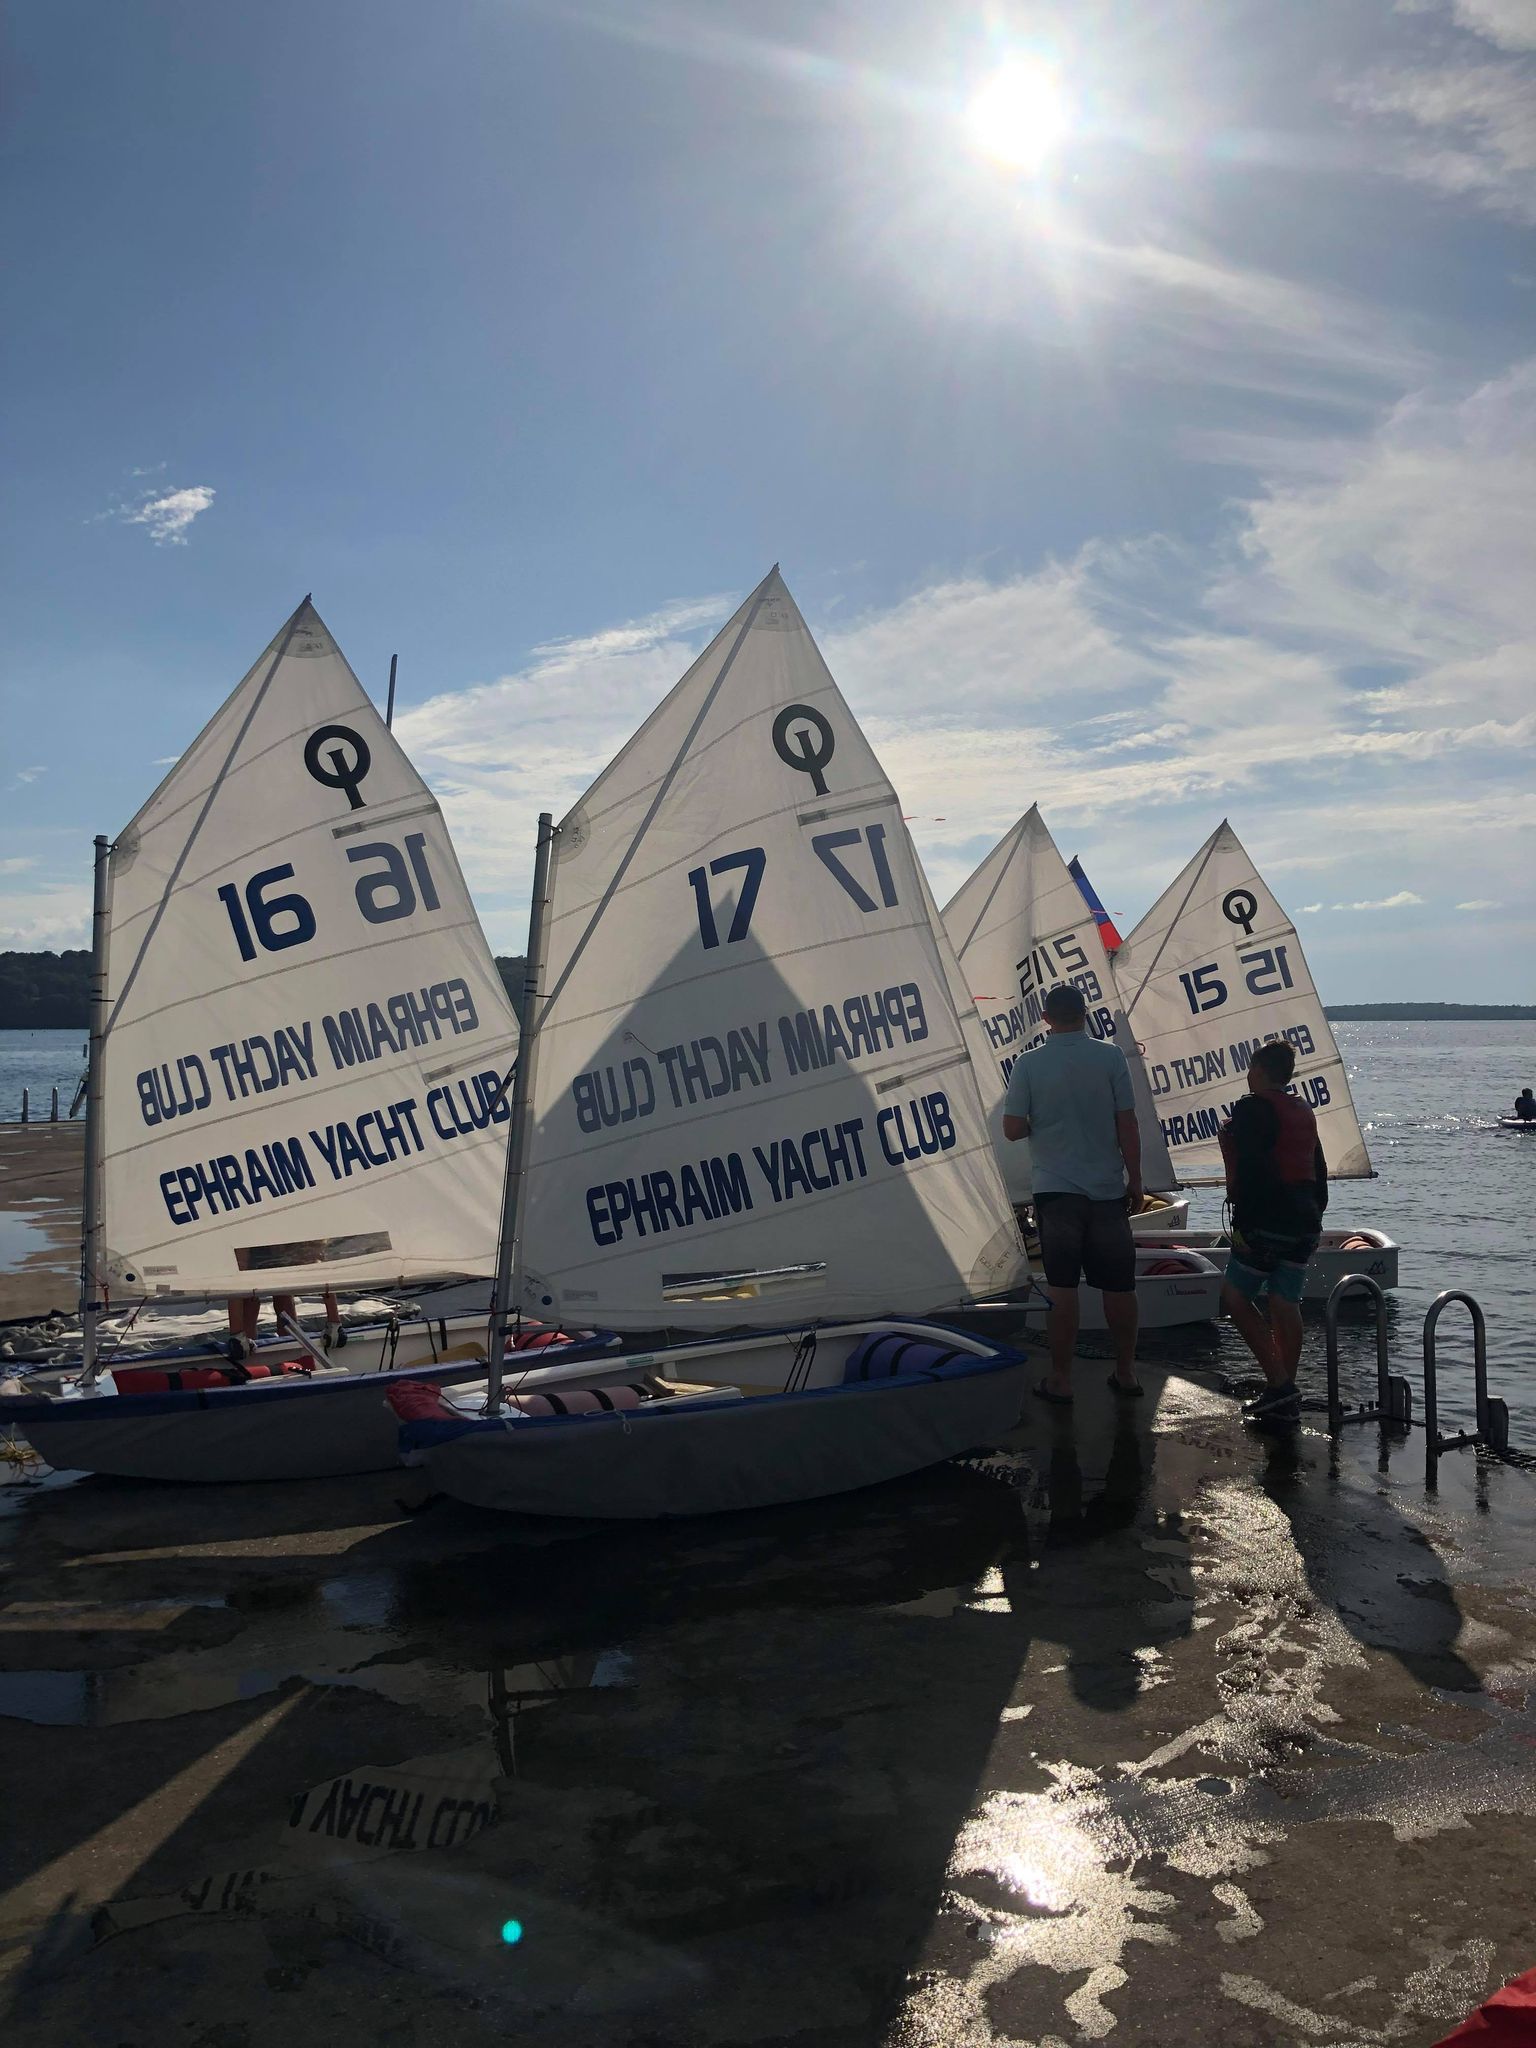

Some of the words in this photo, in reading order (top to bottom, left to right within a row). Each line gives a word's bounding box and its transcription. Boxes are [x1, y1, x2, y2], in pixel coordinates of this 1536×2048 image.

[217, 863, 317, 963] 16
[688, 847, 767, 950] 17
[1179, 963, 1228, 1014] 15
[160, 1137, 316, 1226] EPHRAIM
[308, 1098, 424, 1181] YACHT
[427, 1069, 511, 1141] CLUB
[586, 1152, 754, 1246] EPHRAIM
[752, 1118, 868, 1202] YACHT
[876, 1091, 957, 1166] CLUB
